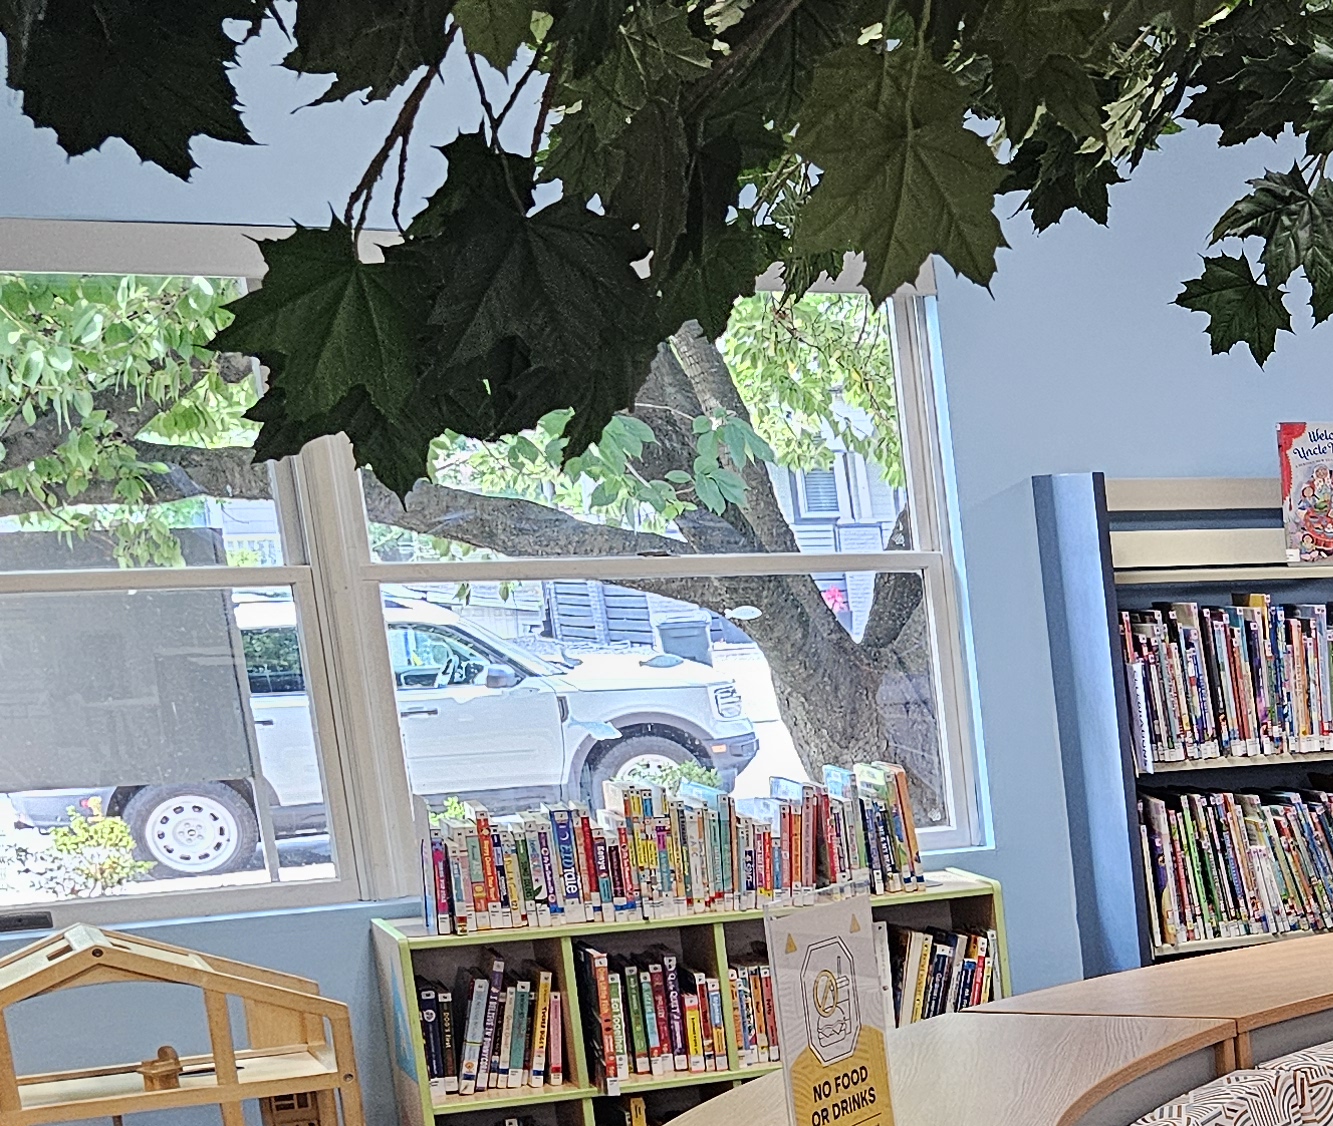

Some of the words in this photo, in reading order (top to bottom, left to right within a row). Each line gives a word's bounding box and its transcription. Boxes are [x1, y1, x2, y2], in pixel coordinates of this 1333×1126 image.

[1293, 446, 1327, 461] Uncle
[595, 845, 607, 870] Kenya
[562, 867, 578, 894] Tale
[611, 1014, 624, 1053] Together
[812, 1079, 832, 1103] NO
[835, 1064, 869, 1092] FOOD
[832, 1086, 877, 1120] DRINKS
